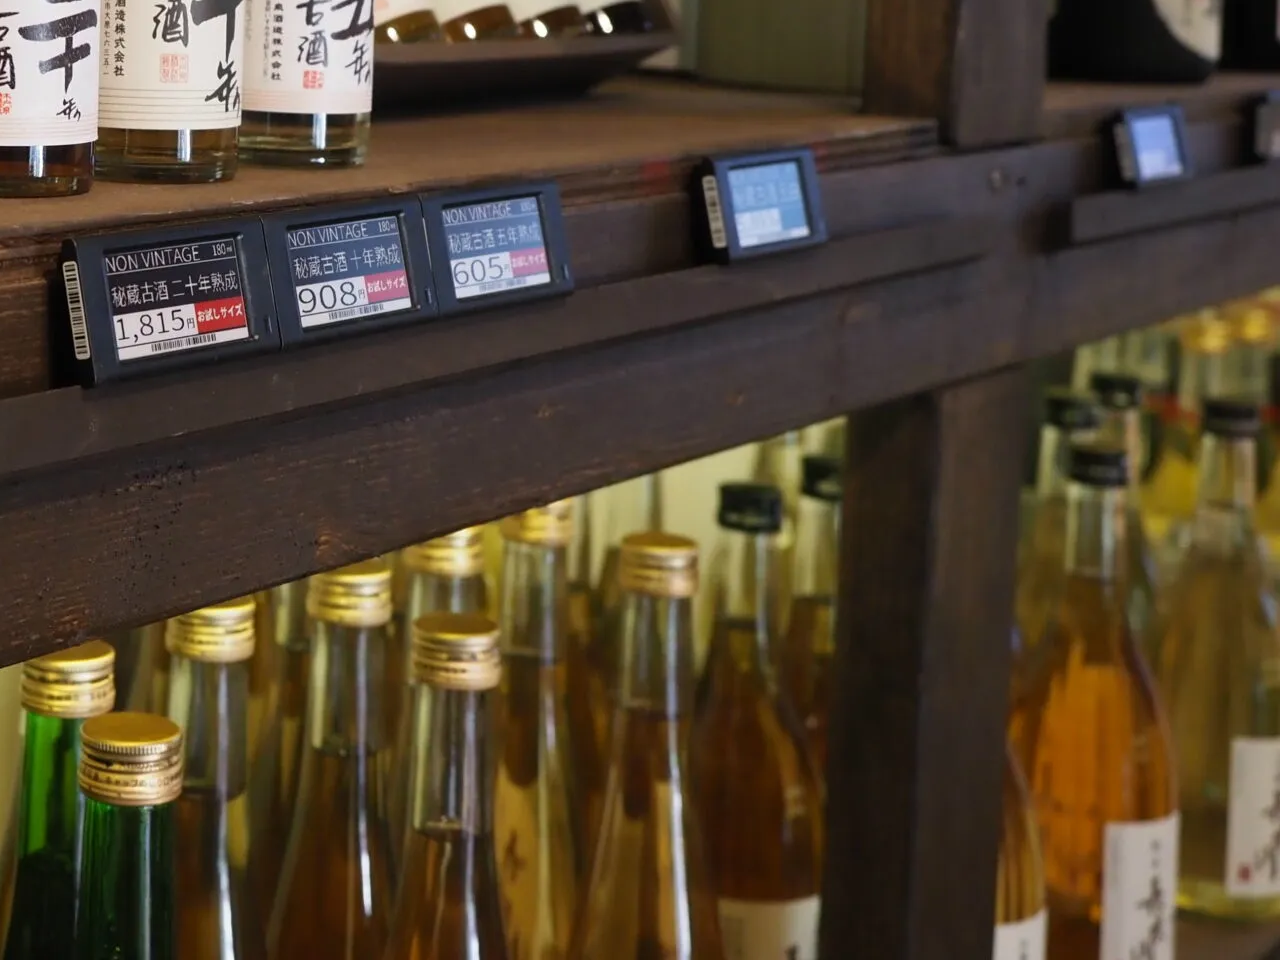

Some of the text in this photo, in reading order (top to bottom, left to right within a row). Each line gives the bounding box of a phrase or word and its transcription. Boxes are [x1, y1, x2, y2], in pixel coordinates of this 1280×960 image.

[442, 209, 467, 224] NON
[468, 202, 512, 220] VINTAGE
[288, 231, 316, 247] NON
[318, 223, 368, 243] VINTAGE
[105, 254, 138, 273] NON
[143, 246, 200, 268] VINTAGE
[294, 243, 401, 280] 秘蔵古酒 十年熟成
[111, 270, 238, 308] 秘蔵古酒 二十年熟成
[367, 275, 406, 294] お試しサイズ
[116, 308, 196, 344] 1,815円
[197, 303, 243, 324] お試しサイズ
